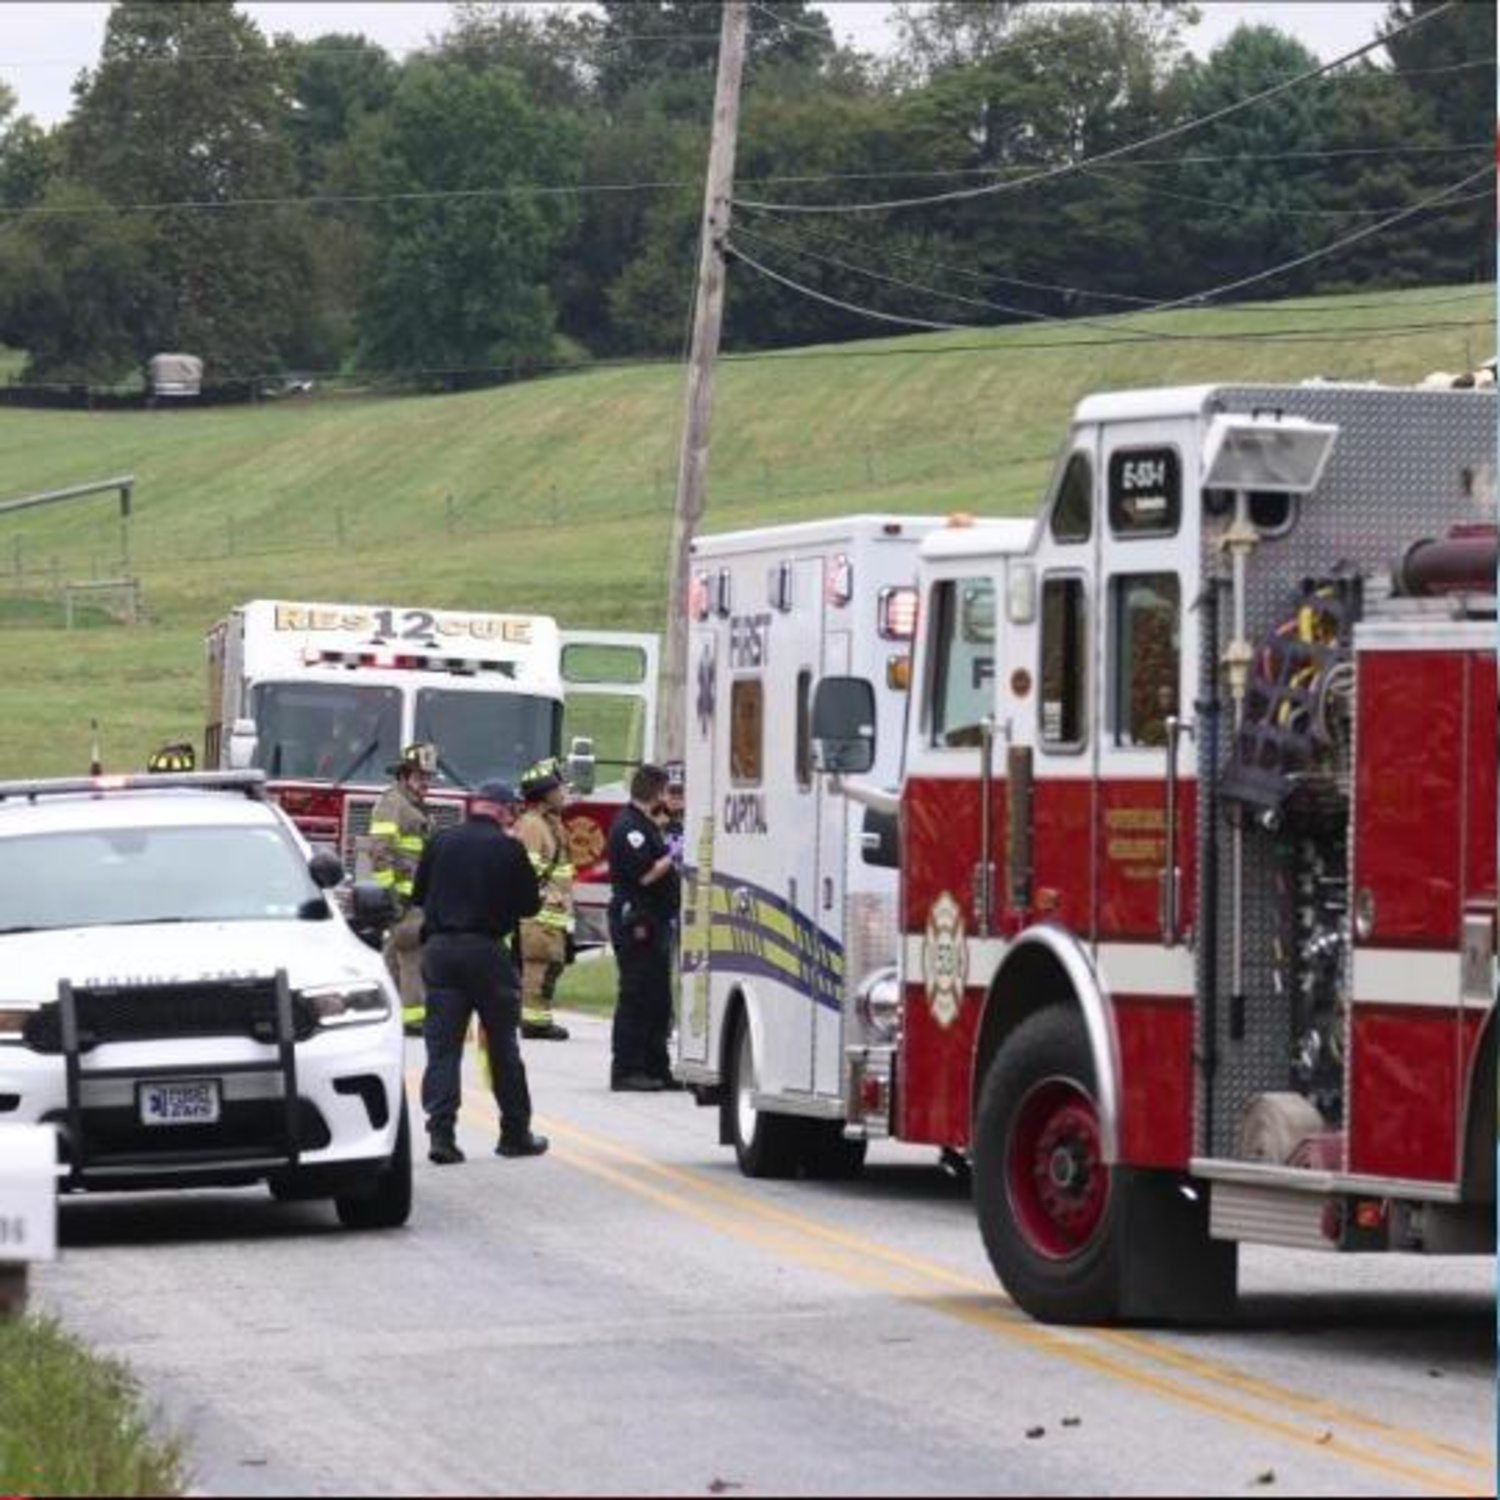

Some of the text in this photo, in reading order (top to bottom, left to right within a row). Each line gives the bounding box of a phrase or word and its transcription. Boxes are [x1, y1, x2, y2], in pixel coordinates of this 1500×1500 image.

[373, 609, 436, 640] 12
[730, 614, 771, 668] FIRST
[724, 795, 768, 835] CAPITAL
